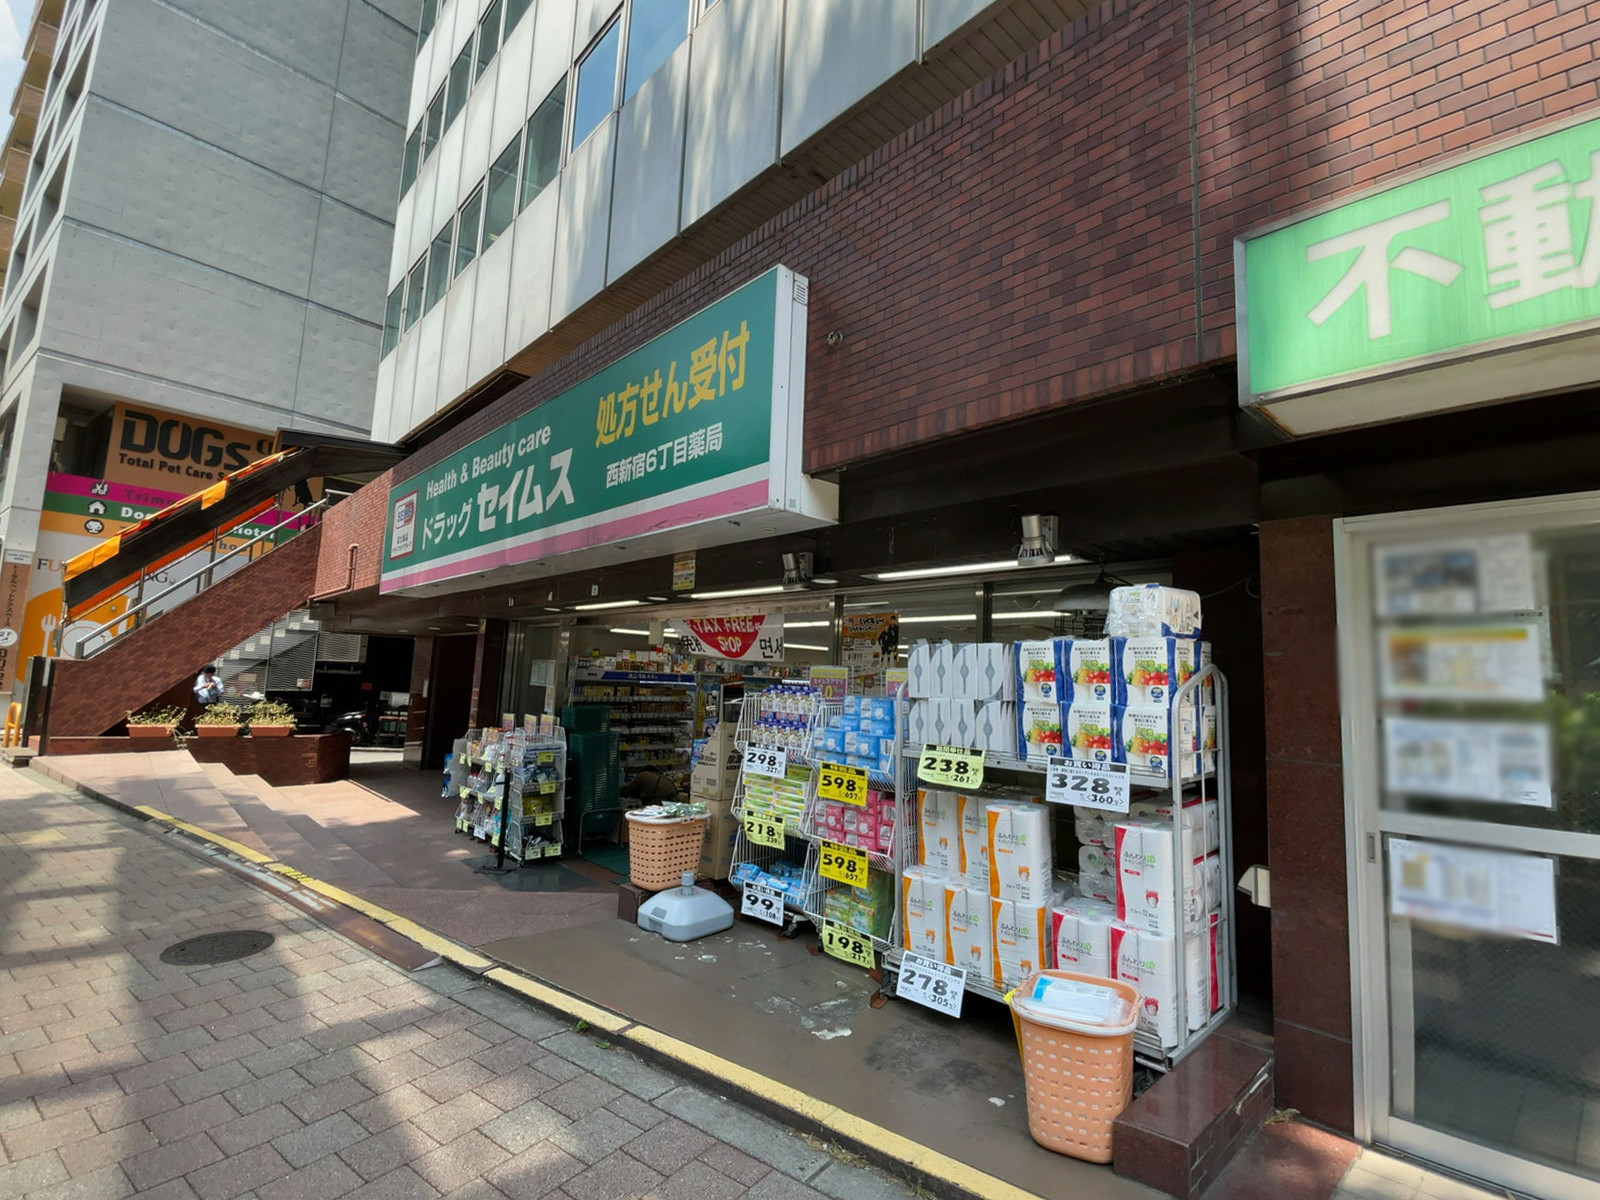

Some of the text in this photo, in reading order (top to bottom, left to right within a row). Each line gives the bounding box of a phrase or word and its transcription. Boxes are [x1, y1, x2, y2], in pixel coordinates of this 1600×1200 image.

[594, 319, 750, 449] 処方せん受付
[426, 425, 551, 500] Health & Beauty care
[605, 421, 723, 488] 西新宿6丁目薬局
[119, 453, 154, 469] Total
[159, 460, 181, 474] Pet
[186, 466, 213, 481] Care
[422, 447, 575, 550] ドラッグ セイムス
[694, 614, 755, 634] TAX FREE
[746, 752, 777, 766] 298
[923, 757, 969, 774] 238
[822, 775, 856, 791] 598
[1051, 773, 1110, 794] 328
[747, 821, 776, 837] 218
[823, 853, 857, 872] 598
[746, 894, 774, 910] 99
[828, 932, 864, 954] 198
[901, 968, 949, 996] 278
